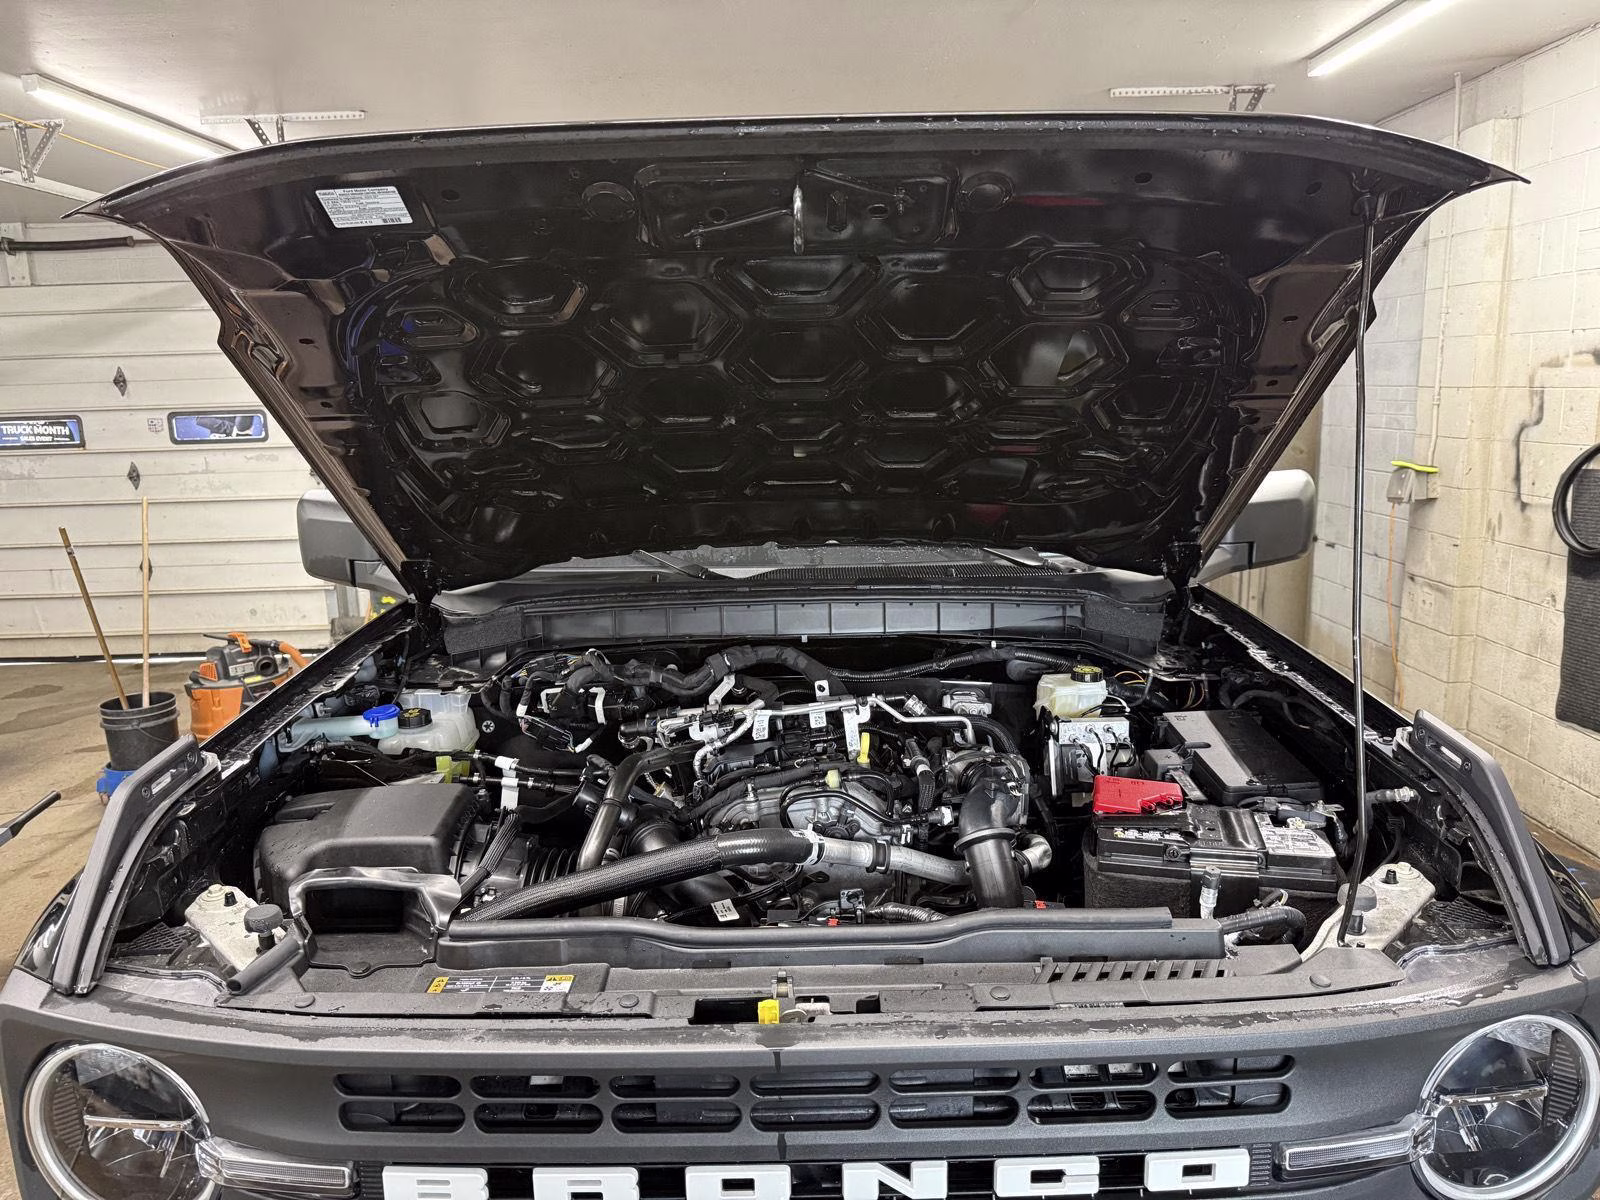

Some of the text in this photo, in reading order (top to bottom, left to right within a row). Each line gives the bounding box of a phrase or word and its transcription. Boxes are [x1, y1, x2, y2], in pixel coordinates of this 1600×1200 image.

[1, 425, 70, 435] TRUCK MONTH
[382, 1149, 1250, 1200] BRONCO
